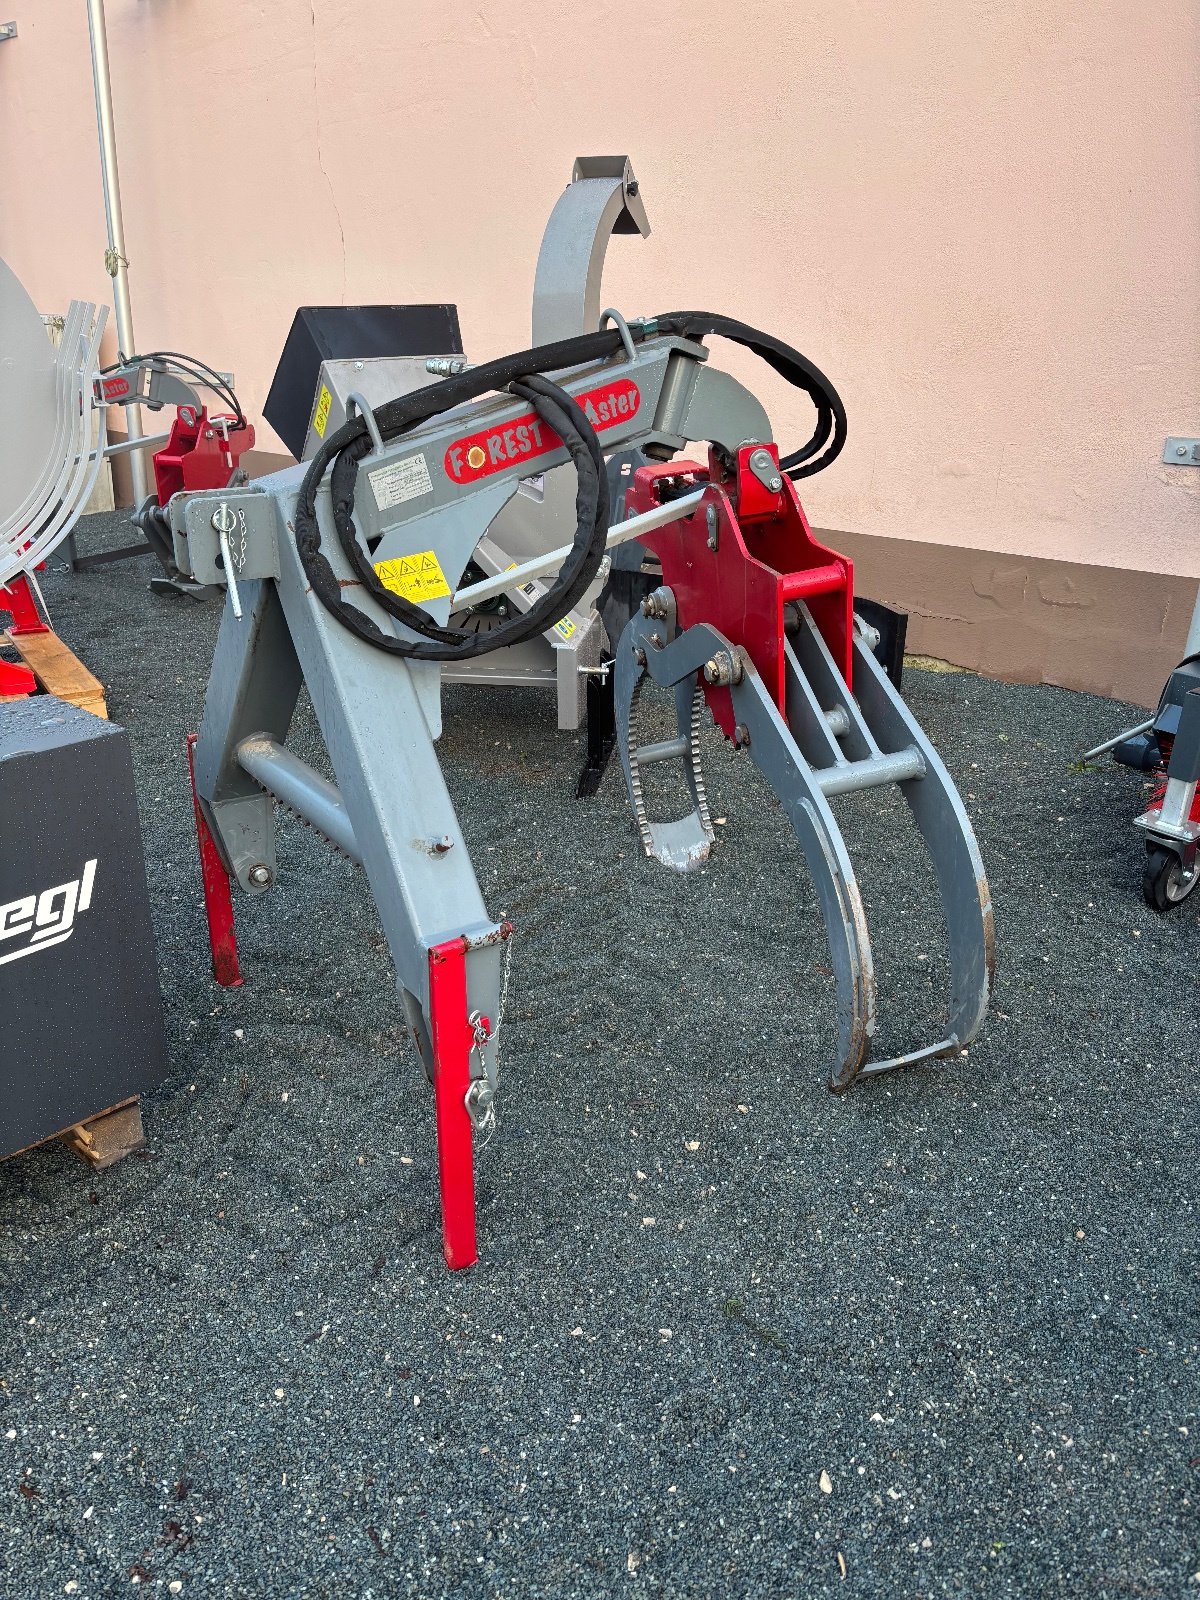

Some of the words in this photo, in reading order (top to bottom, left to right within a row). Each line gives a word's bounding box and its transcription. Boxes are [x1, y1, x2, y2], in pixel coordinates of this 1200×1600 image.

[450, 419, 544, 477] FOREST
[585, 389, 638, 426] Aster
[0, 859, 98, 943] egl
